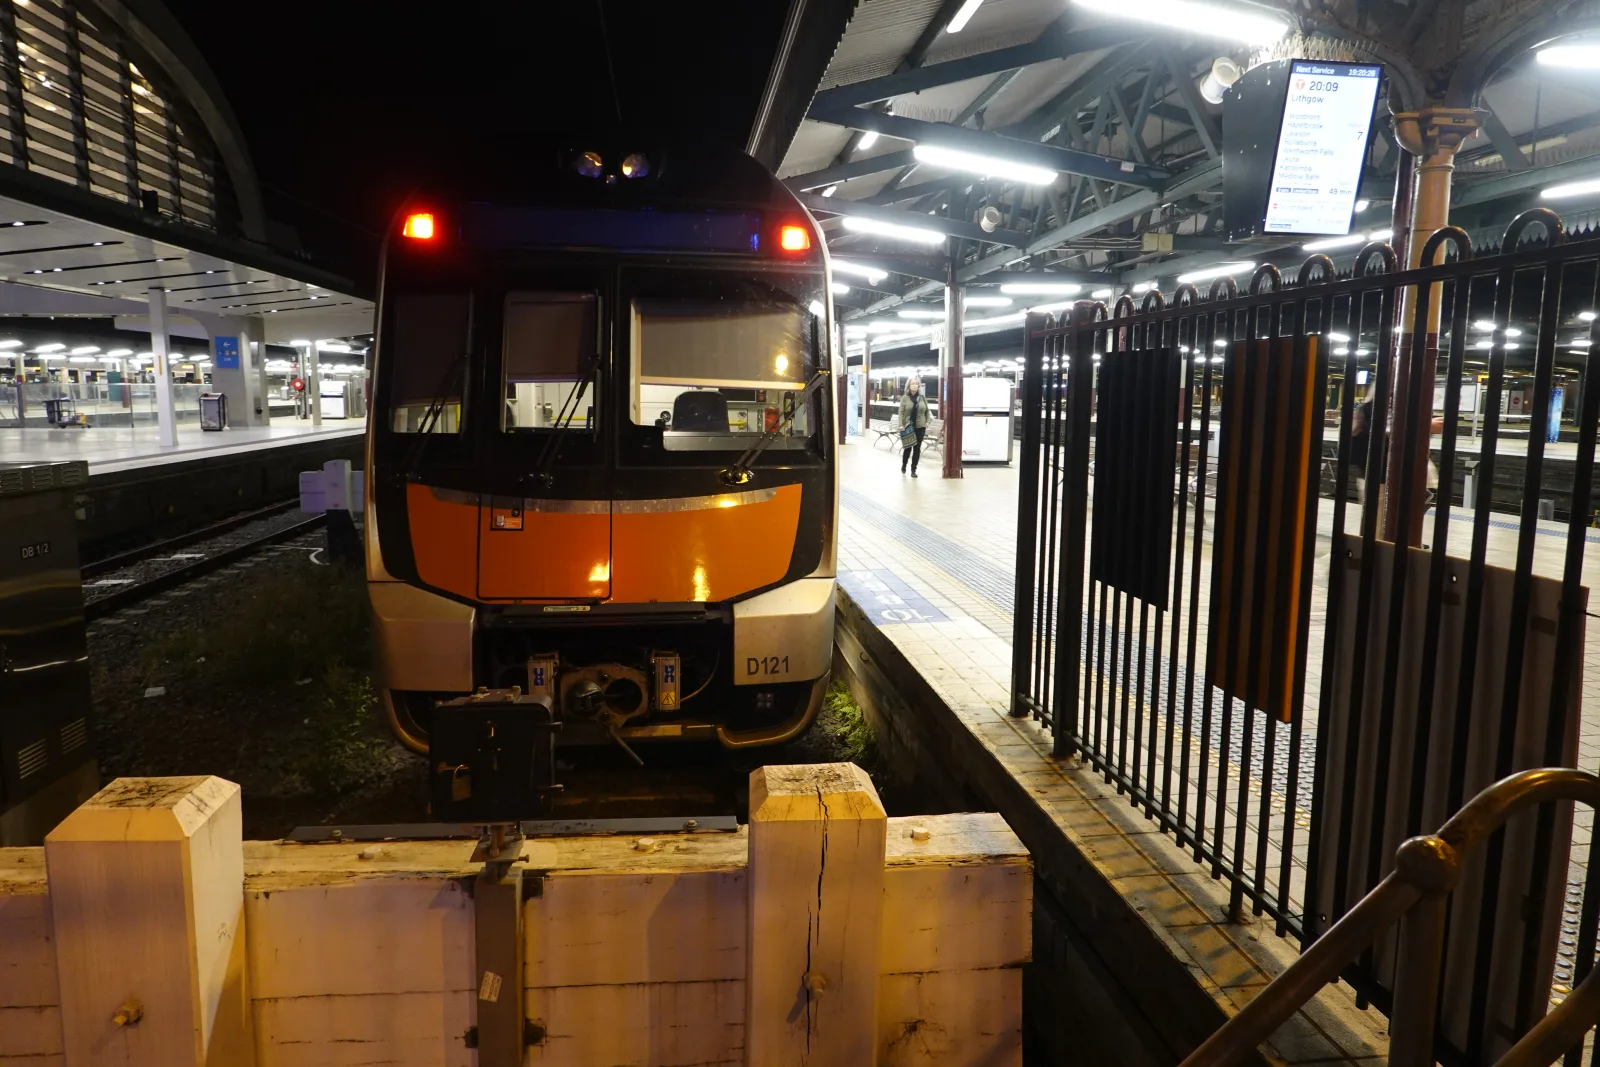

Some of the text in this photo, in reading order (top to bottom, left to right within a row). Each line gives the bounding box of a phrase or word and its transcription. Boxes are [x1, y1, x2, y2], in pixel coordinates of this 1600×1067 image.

[1296, 65, 1335, 75] Next Service
[1309, 81, 1339, 92] 20:09
[1291, 94, 1324, 104] Lithgow
[1357, 131, 1363, 140] 7
[21, 546, 35, 559] DB
[747, 655, 789, 676] D121
